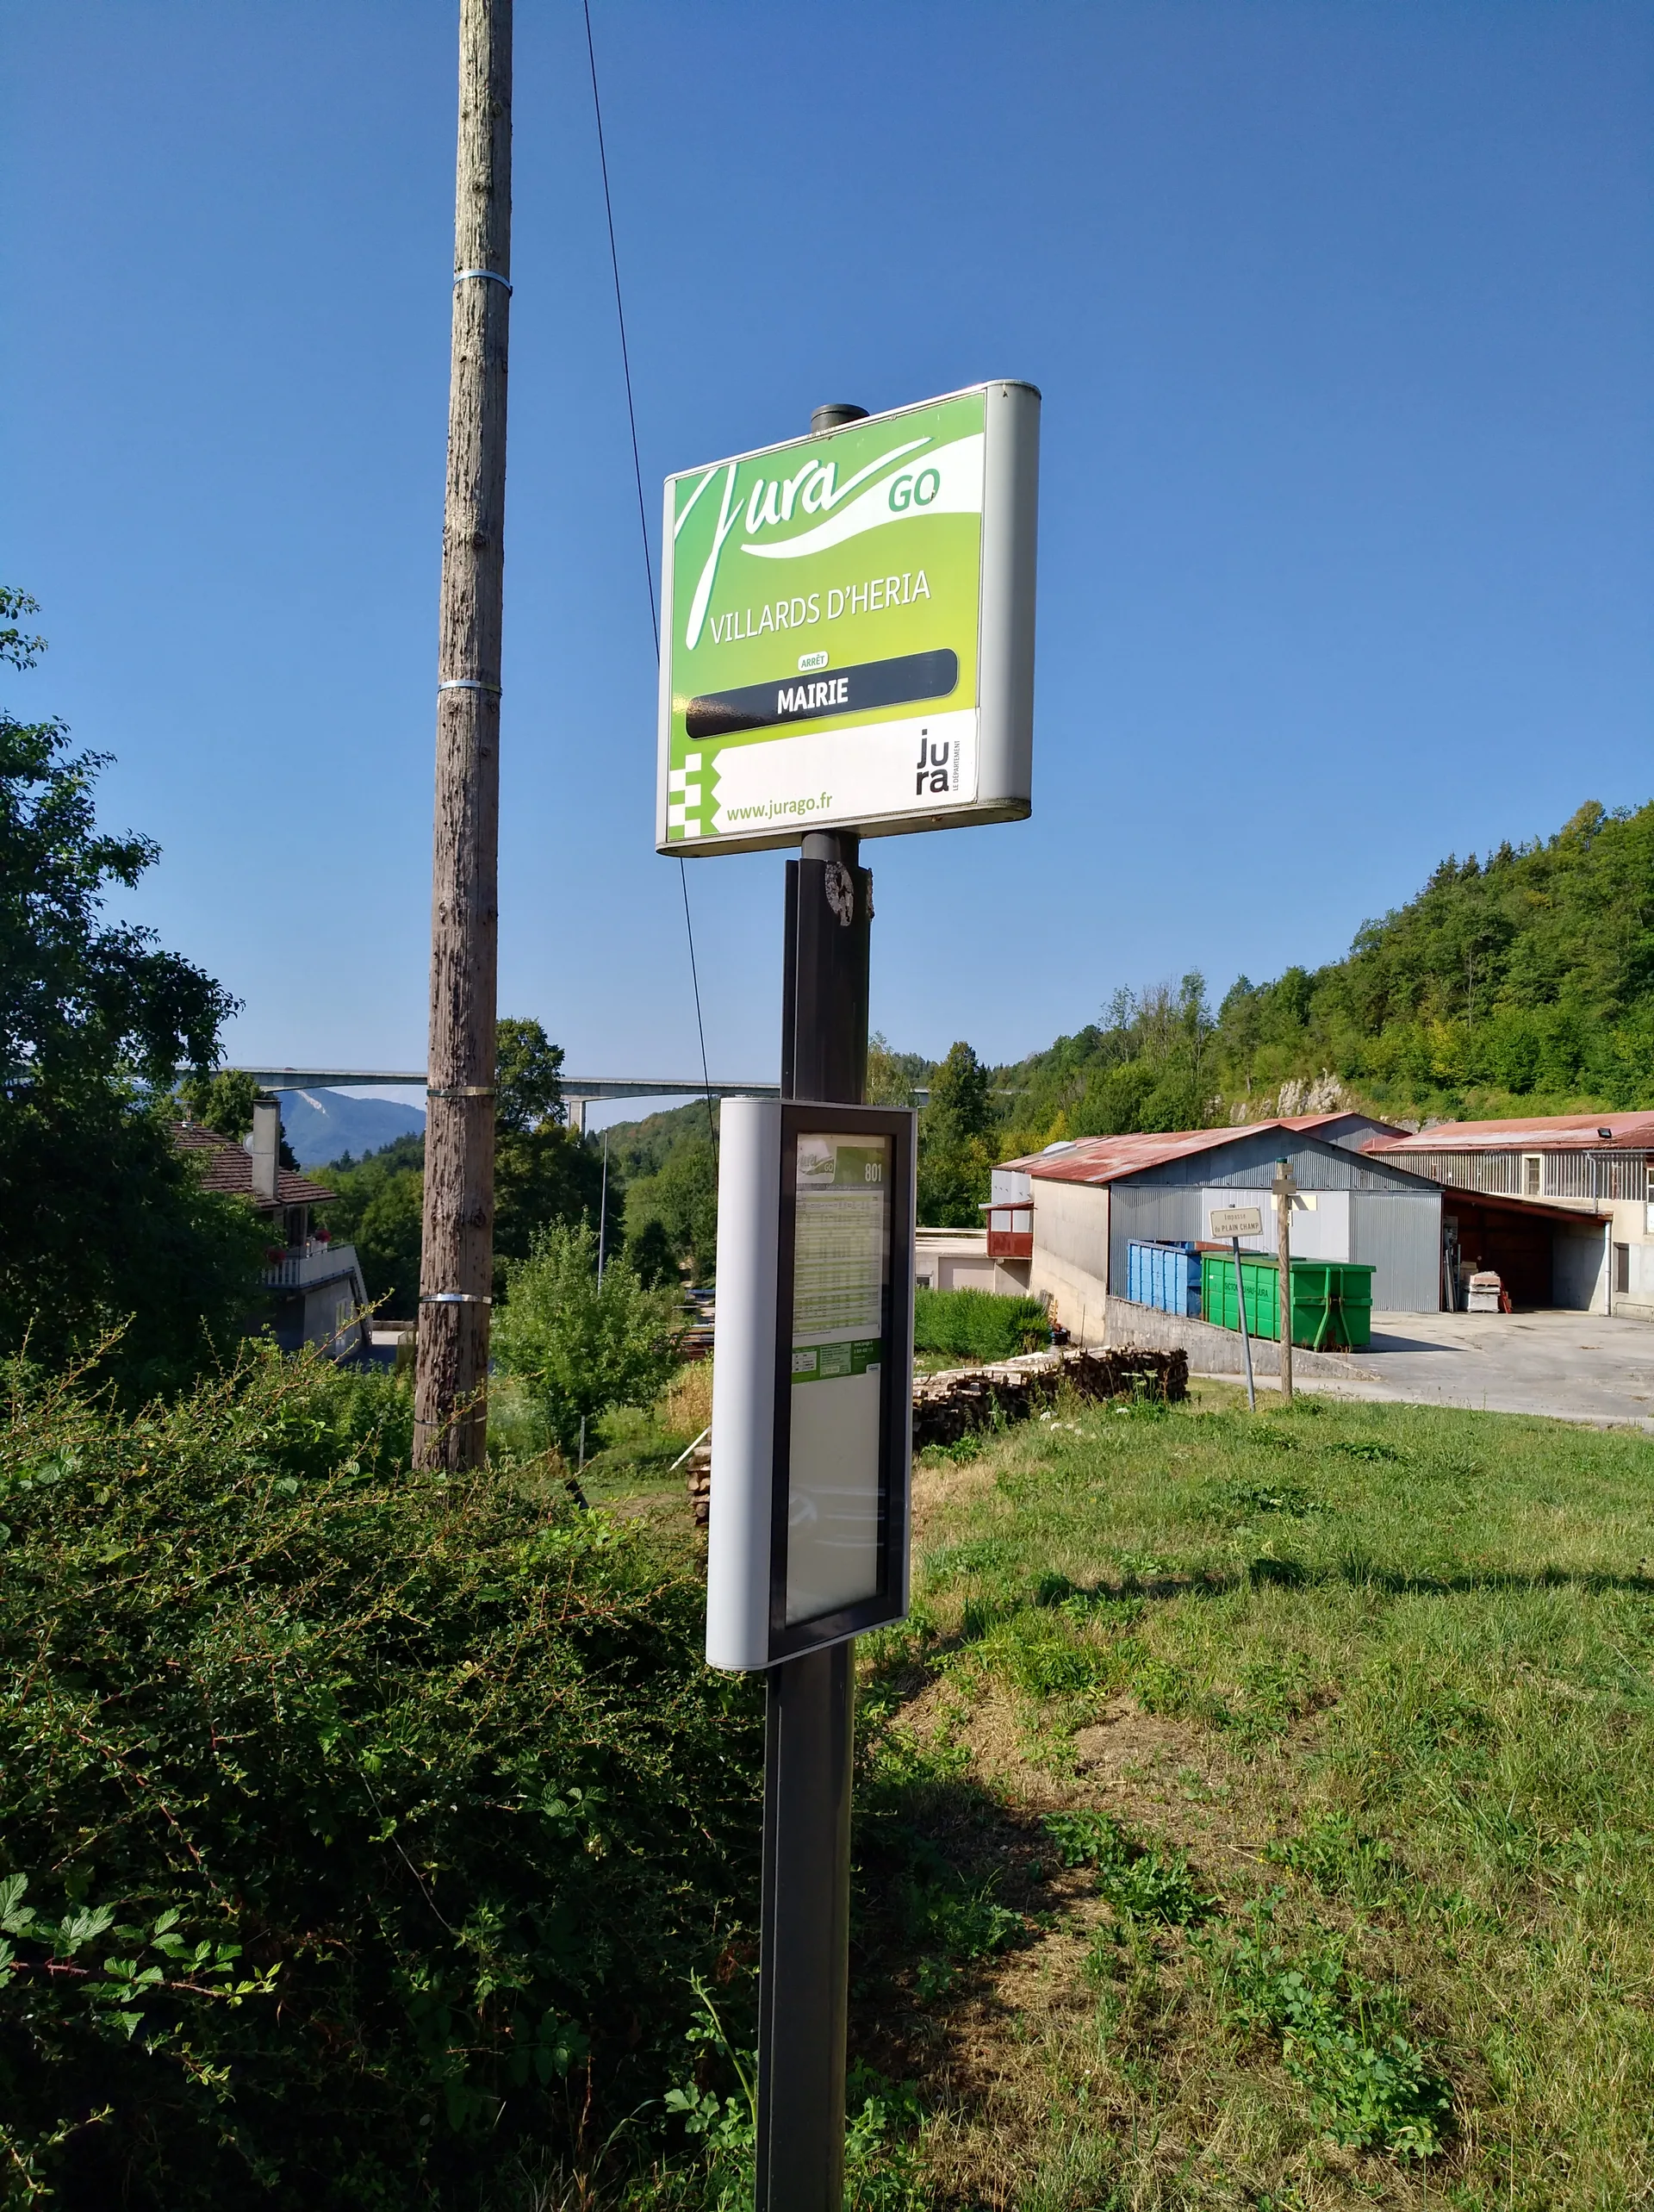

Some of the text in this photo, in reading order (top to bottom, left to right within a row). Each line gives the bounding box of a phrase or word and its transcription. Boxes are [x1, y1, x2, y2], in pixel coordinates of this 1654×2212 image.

[888, 468, 941, 512] GO
[710, 593, 821, 645] VILLARDS
[801, 654, 826, 668] ARRÊT
[777, 677, 849, 714] MAIRIE
[952, 740, 961, 783] DÉPARTEMENT
[726, 792, 833, 821] www.jurago.fr
[864, 1162, 882, 1182] 801
[1222, 1224, 1239, 1232] PLAIN
[1240, 1222, 1259, 1231] CHAMP
